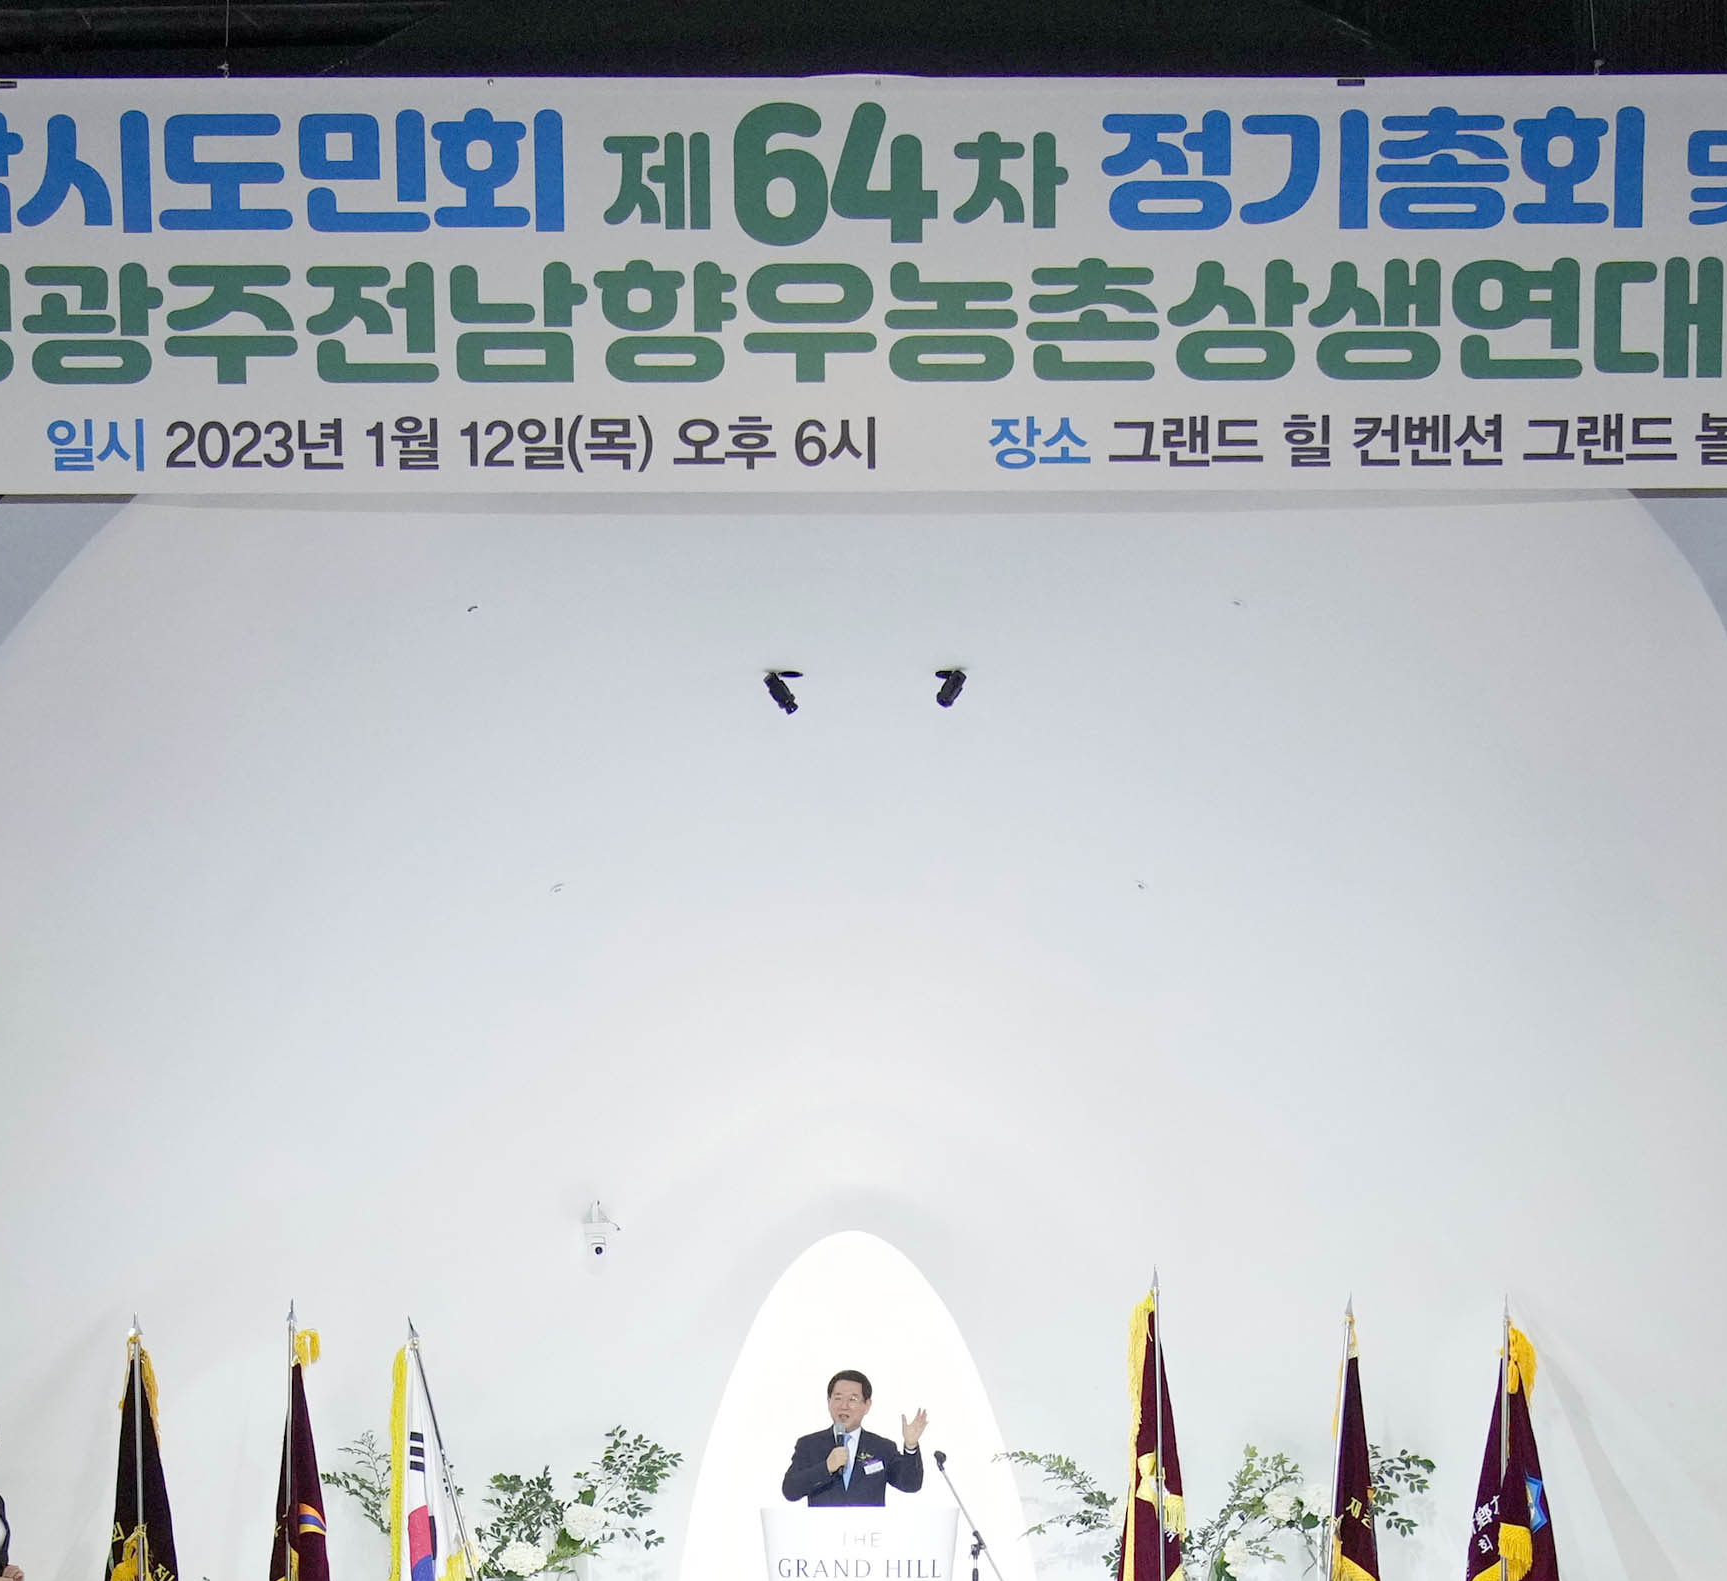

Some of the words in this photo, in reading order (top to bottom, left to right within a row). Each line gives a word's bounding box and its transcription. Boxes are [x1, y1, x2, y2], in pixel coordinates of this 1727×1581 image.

[603, 102, 1068, 246] 제64차
[1102, 106, 1645, 230] 정기총회
[47, 419, 144, 471] 일시
[166, 418, 343, 469] 2023년
[366, 416, 439, 470] 1월
[461, 415, 652, 472] 12일(목)
[674, 416, 776, 469] 오후
[795, 417, 875, 469] 6시
[989, 416, 1090, 469] 장소
[1109, 415, 1263, 467] 그랜드
[1283, 414, 1330, 467] 힐
[1353, 414, 1502, 466] 컨벤션
[1523, 413, 1677, 465] 그랜드
[778, 1558, 872, 1579] GRAND
[885, 1558, 942, 1579] HILL
